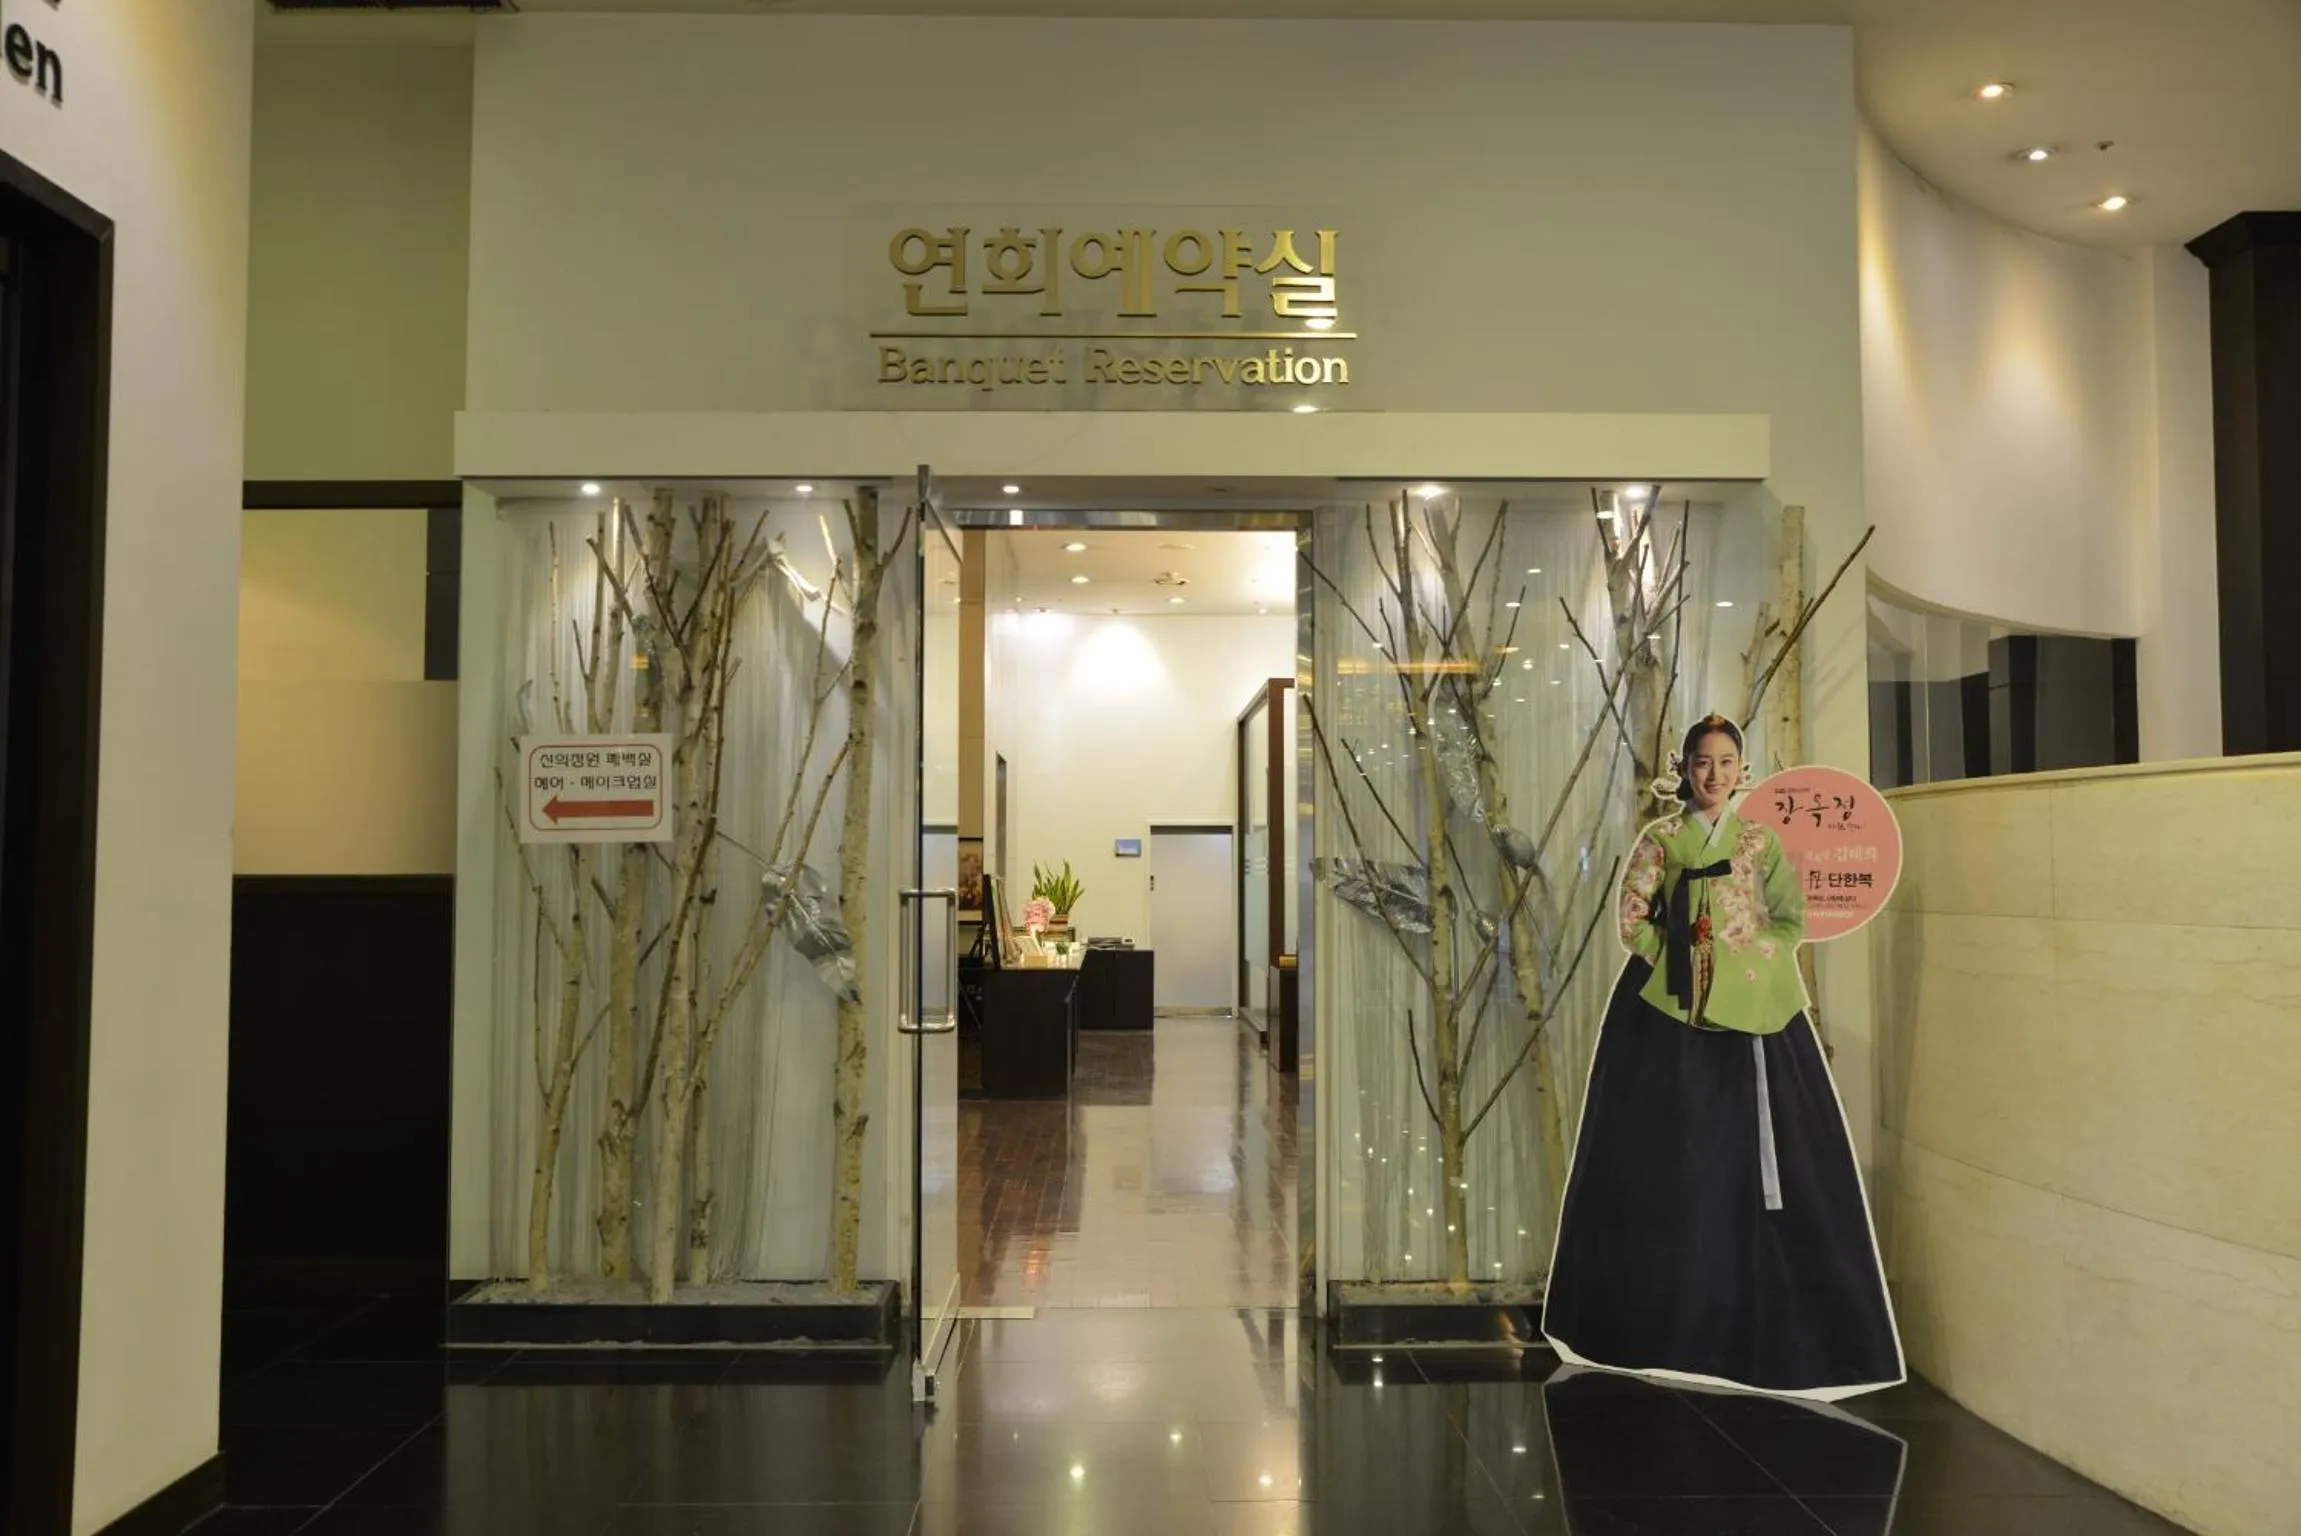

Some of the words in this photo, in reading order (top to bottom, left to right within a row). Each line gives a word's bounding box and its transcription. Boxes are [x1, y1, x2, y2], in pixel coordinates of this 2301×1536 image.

[0, 22, 63, 104] en
[889, 227, 1339, 319] 연회예약실
[877, 346, 1067, 392] Banquet
[1084, 346, 1350, 385] Reservation
[539, 752, 600, 768] 신의정원
[606, 752, 652, 767] 폐백실
[580, 775, 657, 791] 메이크업실
